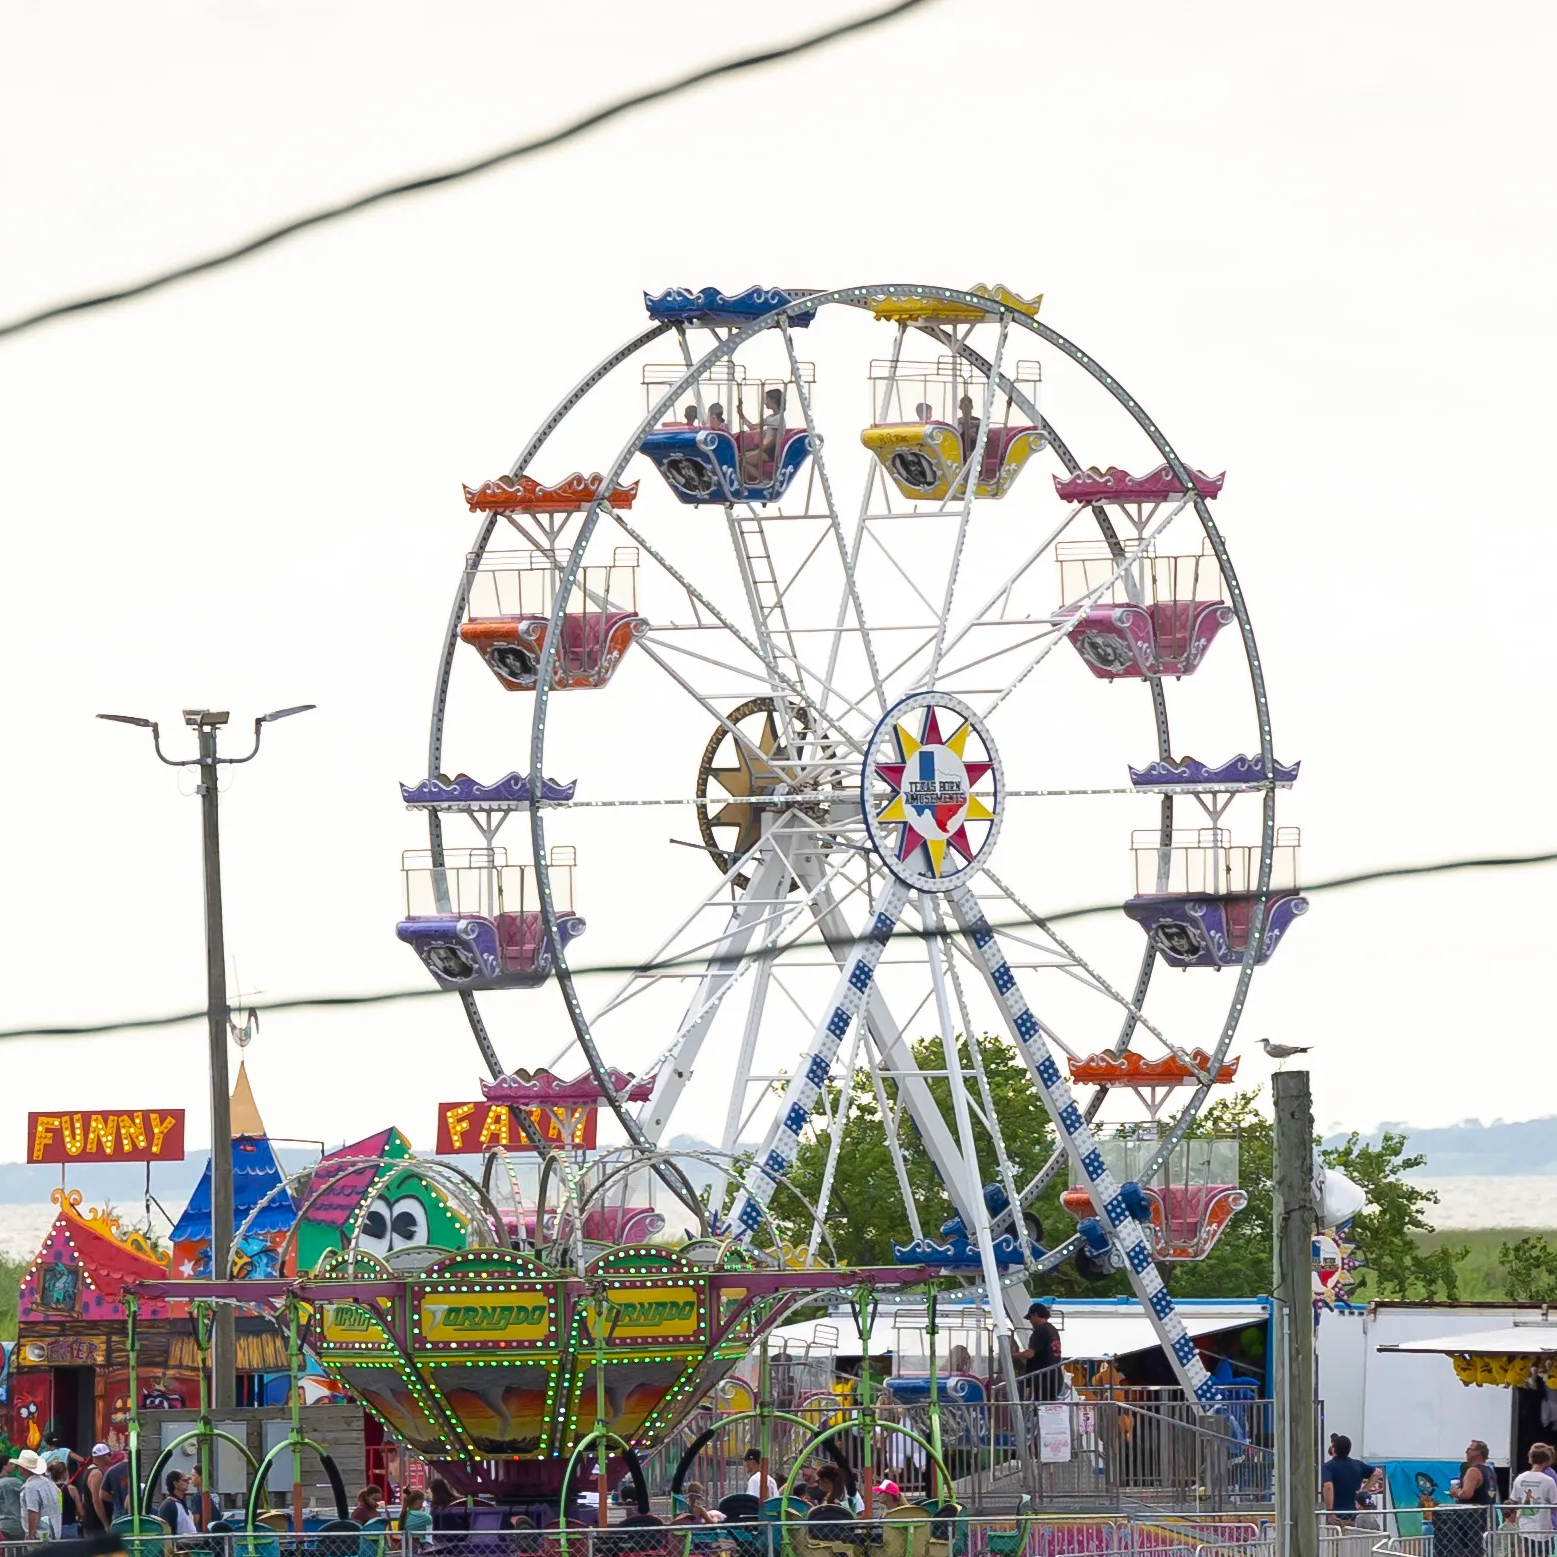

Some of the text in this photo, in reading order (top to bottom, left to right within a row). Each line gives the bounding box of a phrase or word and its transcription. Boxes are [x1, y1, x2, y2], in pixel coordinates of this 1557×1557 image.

[909, 781, 936, 792] TEXAS
[904, 792, 967, 804] AMUSEMENTS
[32, 1110, 176, 1161] FUNNY
[423, 1304, 545, 1331] TORNADO
